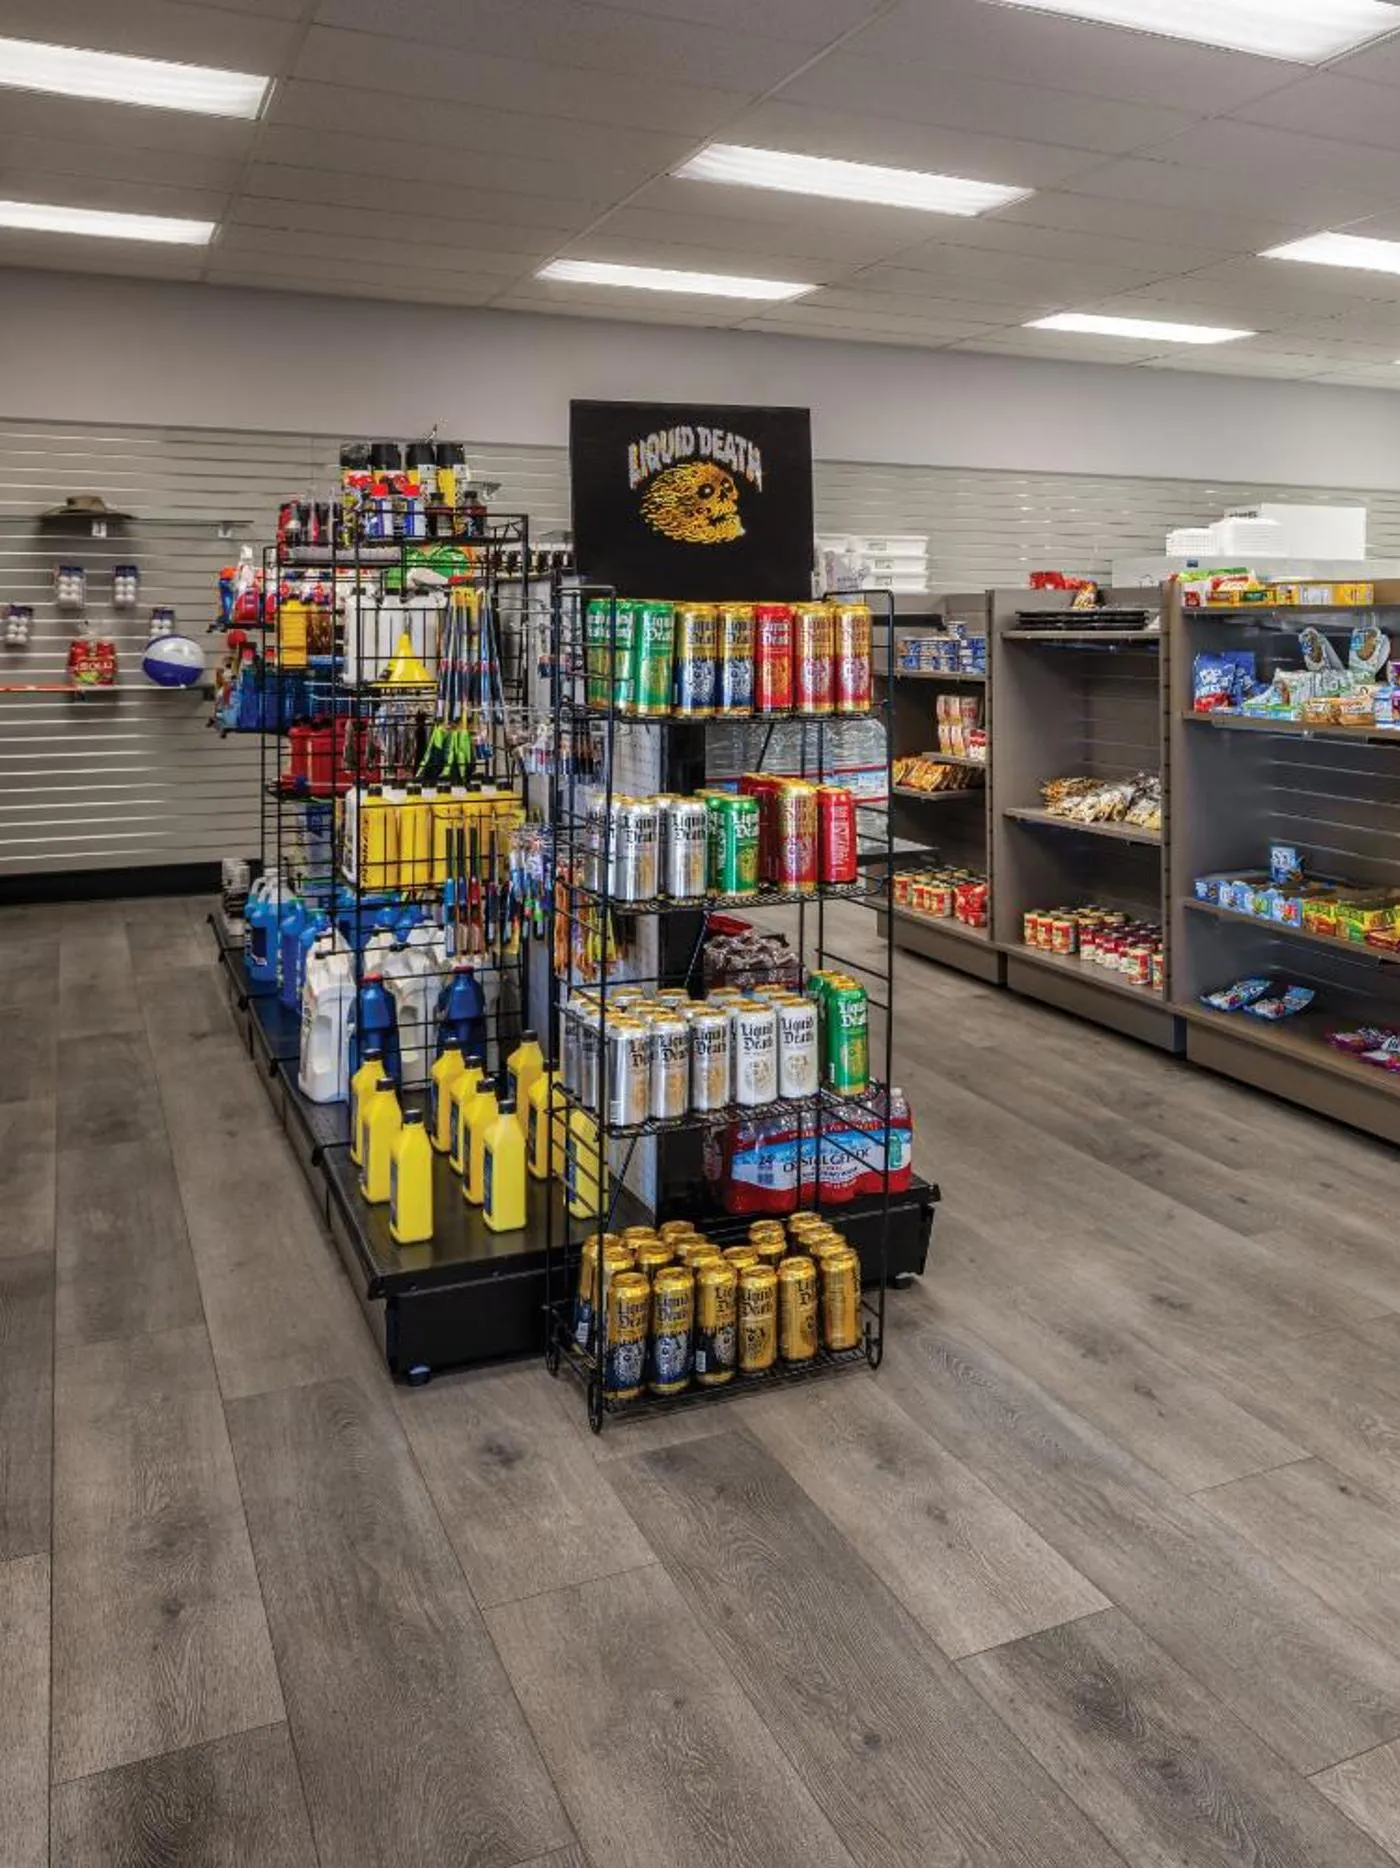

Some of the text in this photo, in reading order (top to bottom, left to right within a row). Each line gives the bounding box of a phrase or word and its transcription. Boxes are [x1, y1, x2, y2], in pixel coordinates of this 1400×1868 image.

[628, 425, 763, 493] LIQUID DEATH
[741, 1022, 774, 1040] Liquid
[781, 1016, 815, 1034] Liquid
[742, 1036, 774, 1051] Death
[782, 1031, 815, 1045] Death
